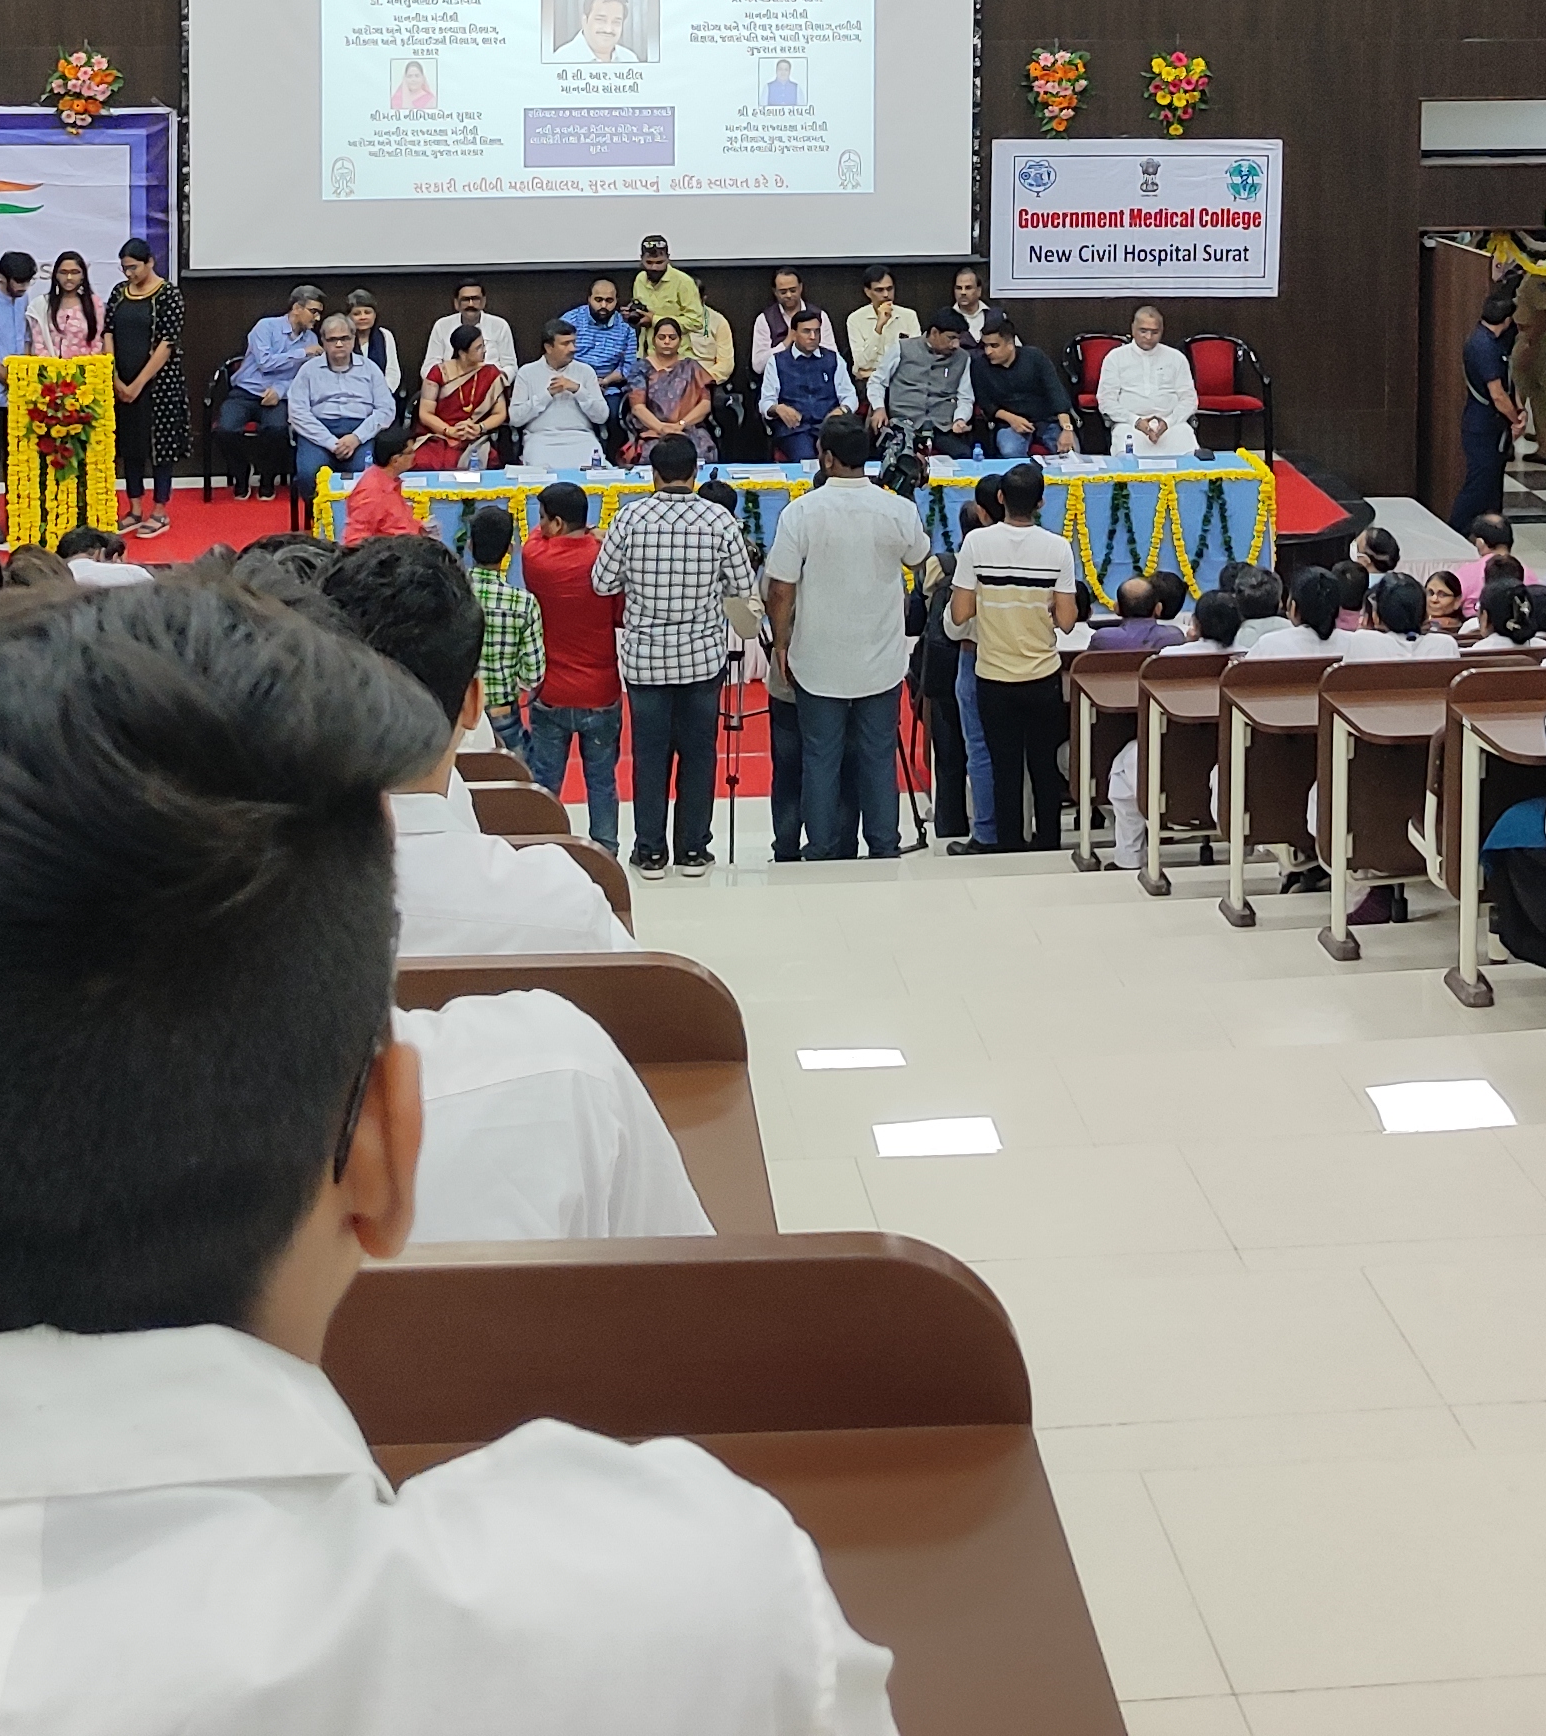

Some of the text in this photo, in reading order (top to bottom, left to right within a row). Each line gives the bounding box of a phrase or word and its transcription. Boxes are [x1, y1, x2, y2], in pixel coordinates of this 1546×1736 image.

[393, 13, 428, 23] માનનીય
[745, 9, 778, 19] માનનીય
[352, 25, 383, 35] આરોગ્ય
[386, 25, 402, 34] અને
[405, 24, 436, 34] પરિવાર
[438, 26, 466, 34] કલ્યાણ
[691, 21, 721, 31] આરોગ્ય
[724, 22, 739, 31] અને
[743, 22, 772, 32] પરિવાર
[775, 23, 802, 31] કલ્યાણ
[381, 37, 397, 46] અને
[482, 37, 505, 45] ભારત
[761, 33, 775, 42] અને
[747, 47, 777, 55] ગુજરાત
[556, 70, 568, 81] શ્રી
[589, 71, 611, 80] આર.
[614, 69, 643, 80] પાટીલ
[561, 83, 639, 94] માનનીય સાંસદશ્રી
[370, 110, 400, 121] શ્રીમતી
[456, 111, 482, 122] સુથાર
[738, 105, 748, 116] શ્રી
[374, 127, 408, 137] માનનીય
[725, 122, 759, 132] માનનીય
[414, 178, 457, 193] સરકારી
[463, 177, 504, 192] તબીબી
[588, 179, 618, 193] સુરત
[622, 176, 659, 193] આપનું
[670, 175, 702, 190] હાર્દિક
[708, 178, 749, 189] સ્વાગત
[754, 175, 768, 188] કરે
[774, 175, 788, 188] છે.
[1018, 207, 1261, 230] Government Medical College
[1029, 244, 1249, 266] New Civil Hospital Surat
